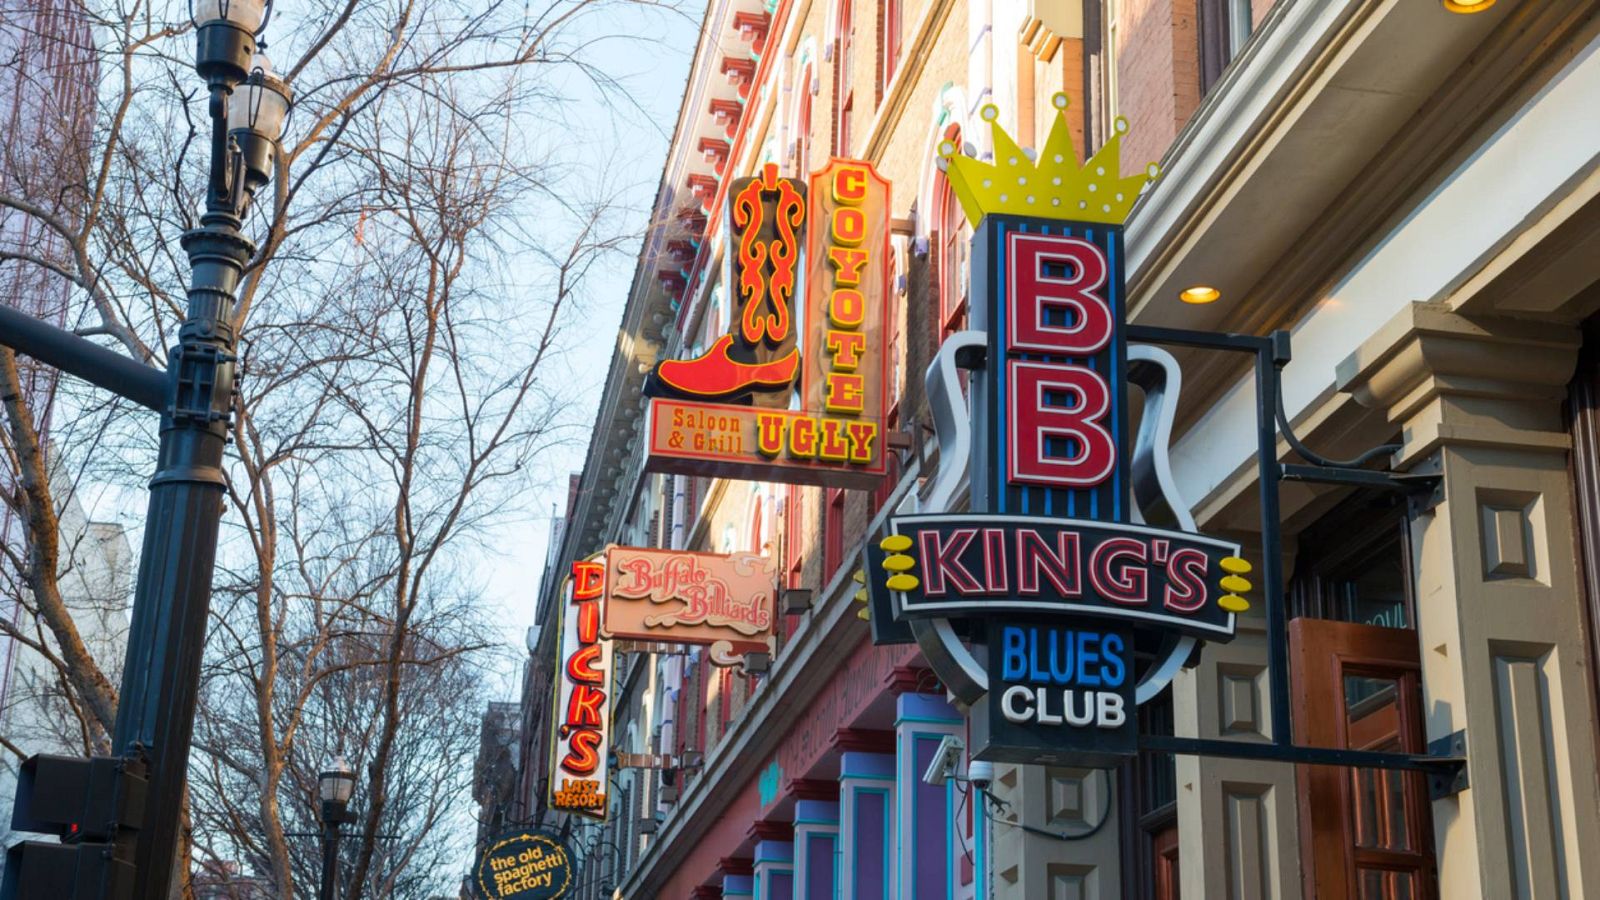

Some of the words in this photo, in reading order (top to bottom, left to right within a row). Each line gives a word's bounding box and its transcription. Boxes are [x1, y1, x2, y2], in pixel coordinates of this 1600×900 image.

[827, 168, 869, 413] COYOTE
[673, 407, 741, 433] Saloon
[757, 412, 878, 464] UGLY
[668, 430, 685, 449] &
[693, 431, 742, 455] Grill
[619, 557, 707, 596] Buffalo
[918, 529, 1209, 614] KING'S
[676, 577, 770, 627] Billiards
[560, 561, 605, 775] DICK'S
[1003, 626, 1127, 687] BLUES
[1000, 686, 1127, 728] CLUB
[555, 791, 605, 807] RESORT
[563, 779, 600, 793] LAST
[491, 856, 516, 871] the
[519, 846, 543, 863] old
[494, 853, 563, 884] spaghetti
[497, 871, 552, 897] factory
